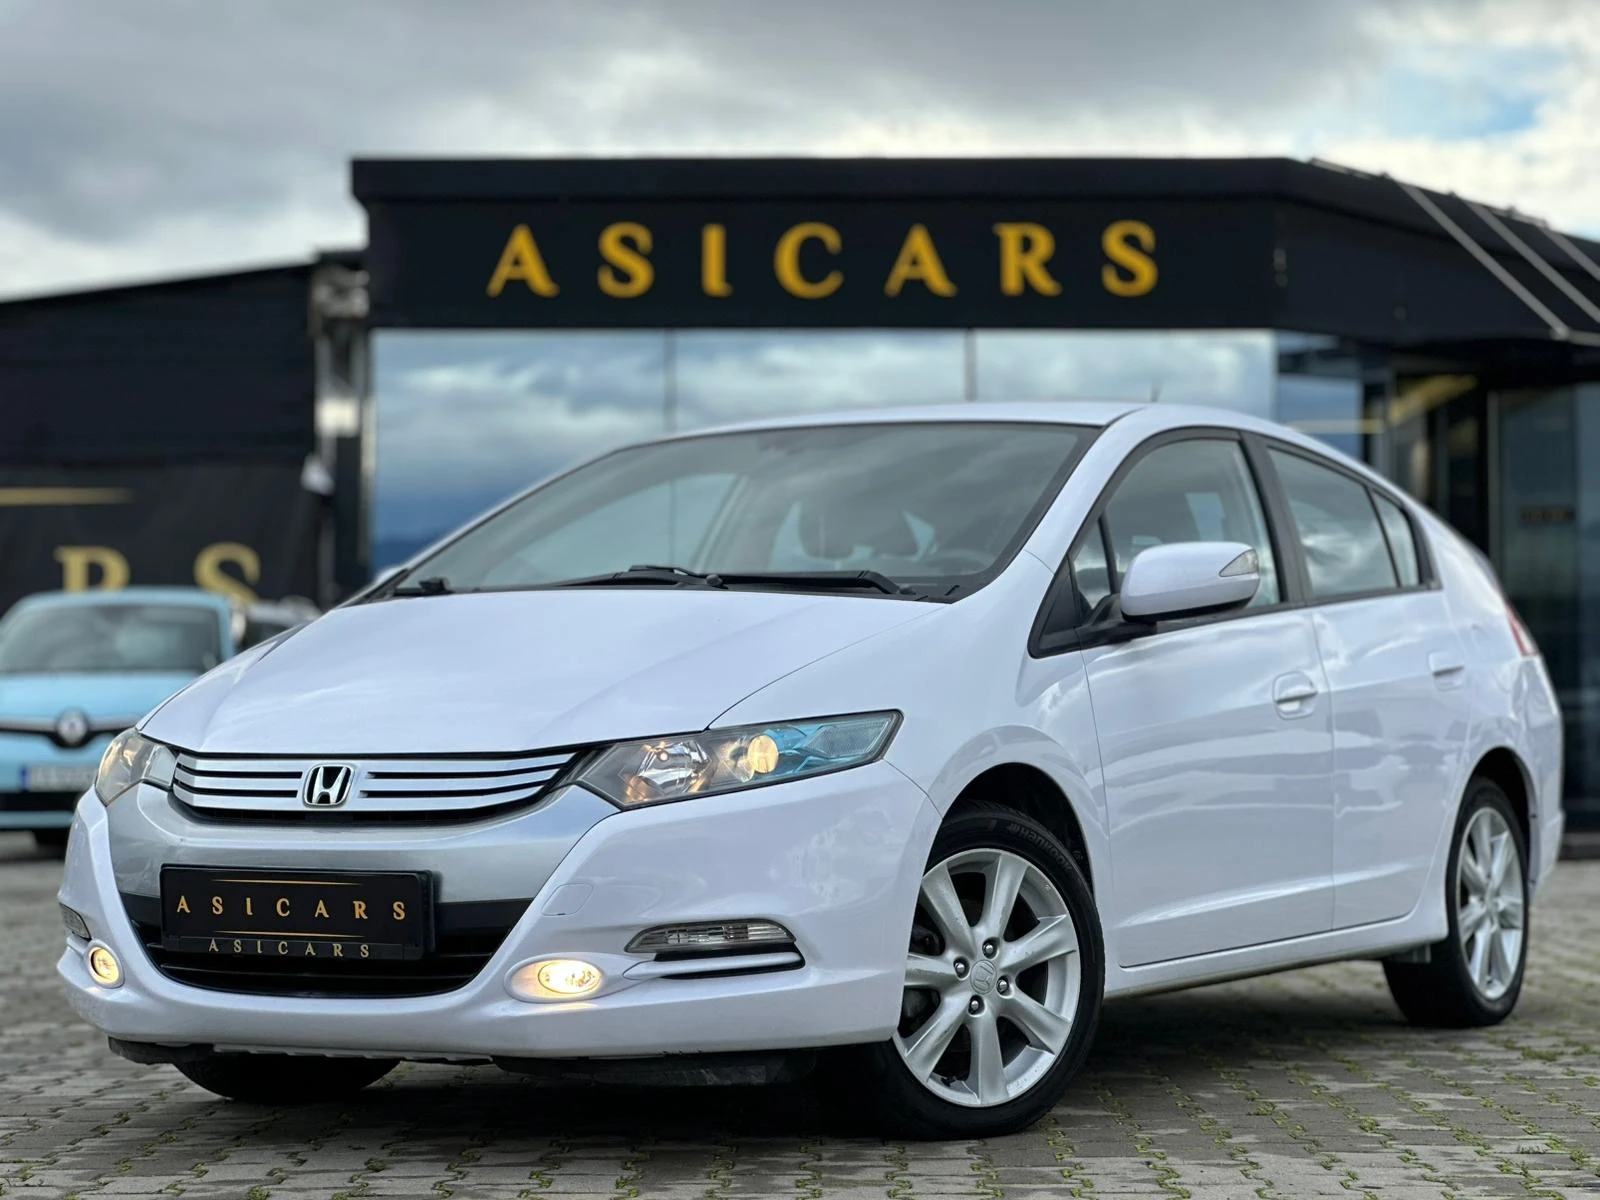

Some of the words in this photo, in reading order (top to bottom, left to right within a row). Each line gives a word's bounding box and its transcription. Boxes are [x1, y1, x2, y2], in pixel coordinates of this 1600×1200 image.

[488, 221, 1158, 298] ASICARS
[177, 896, 406, 920] ASICARS
[208, 937, 370, 959] ASICARS
